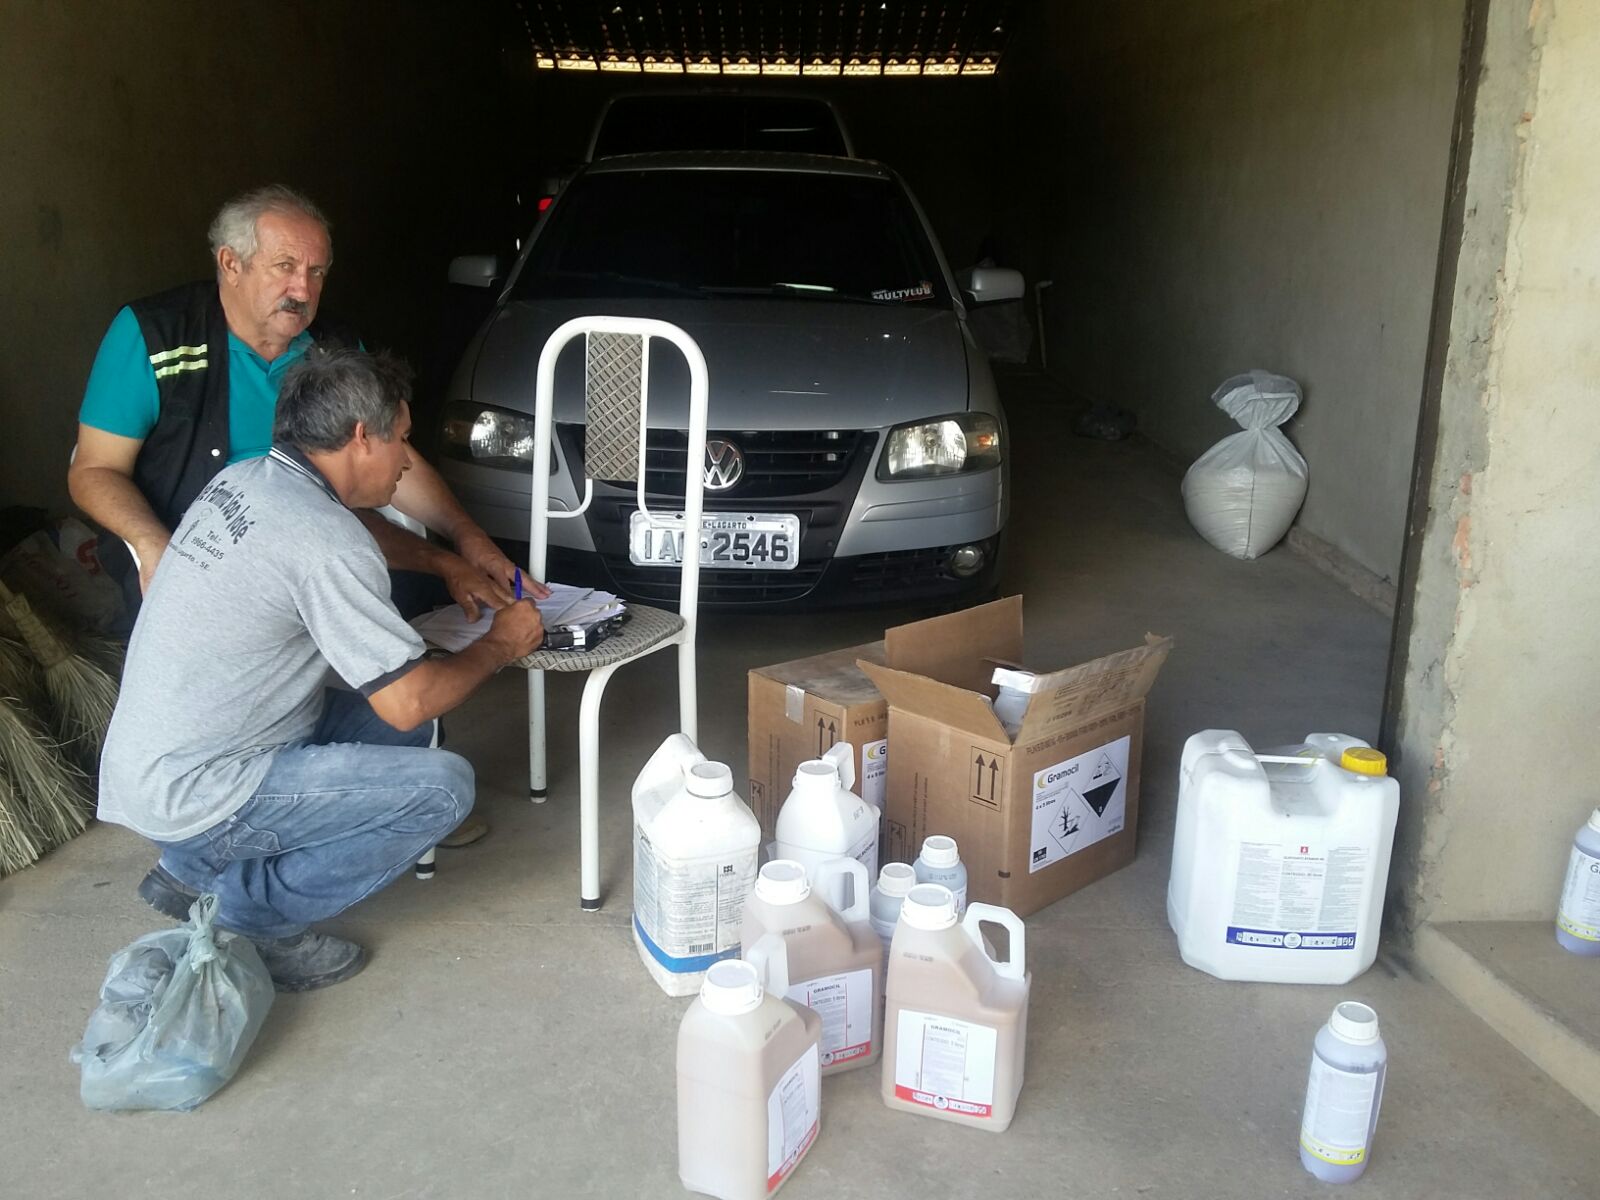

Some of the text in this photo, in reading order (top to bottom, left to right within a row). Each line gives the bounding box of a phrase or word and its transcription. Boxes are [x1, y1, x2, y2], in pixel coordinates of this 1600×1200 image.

[226, 505, 256, 544] José
[713, 532, 789, 562] 2546
[1047, 763, 1079, 784] Gramocil
